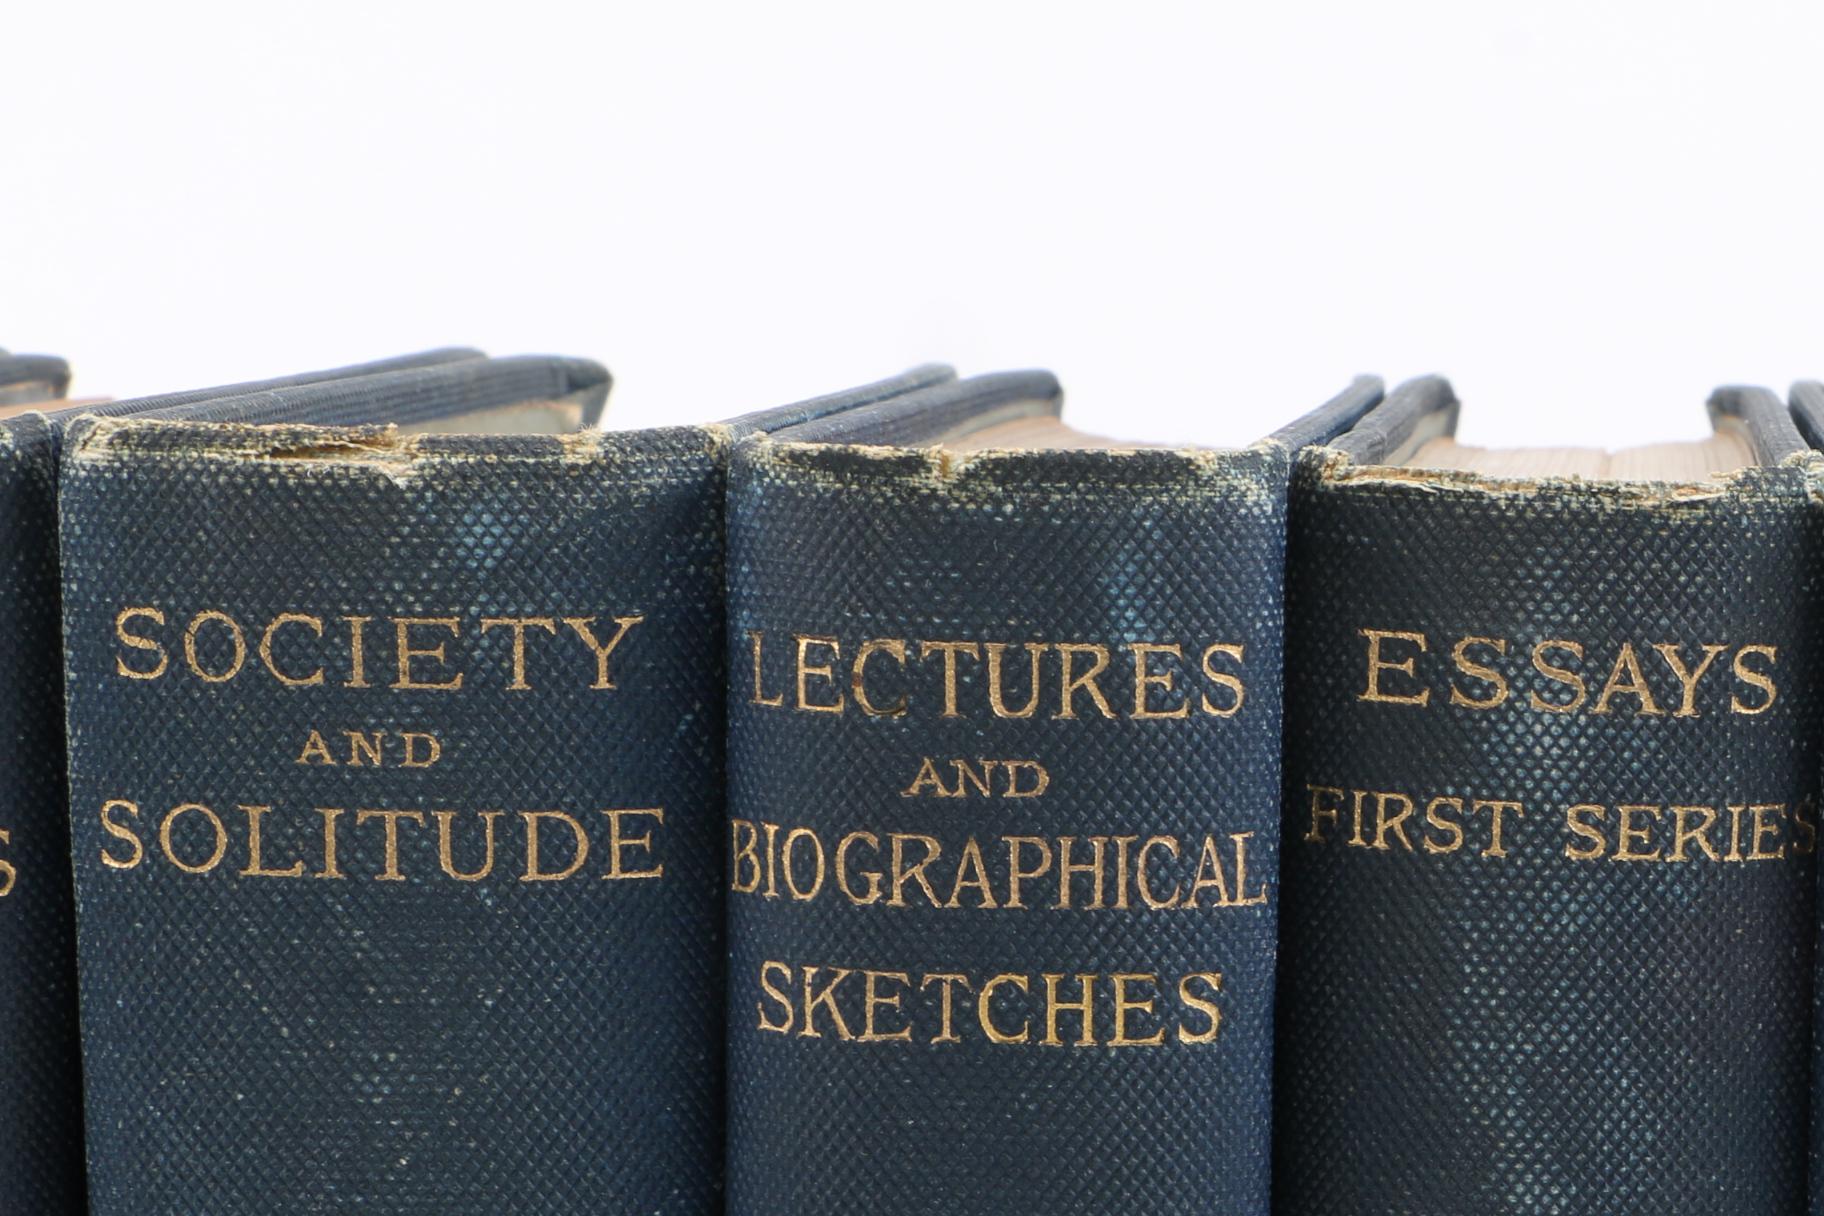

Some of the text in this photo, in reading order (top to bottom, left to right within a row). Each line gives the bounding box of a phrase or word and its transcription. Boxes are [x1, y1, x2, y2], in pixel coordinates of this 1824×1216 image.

[114, 606, 644, 691] SOCIETY
[748, 630, 1247, 720] LECTURES
[1357, 628, 1779, 718] ESSAYS
[296, 729, 442, 768] AND
[901, 757, 1051, 798] AND
[100, 799, 665, 882] SOLITUDE
[731, 818, 1269, 911] BIOGRAPHICAL
[1304, 783, 1817, 863] FIRST SERIES
[757, 960, 1223, 1048] SKETCHES
